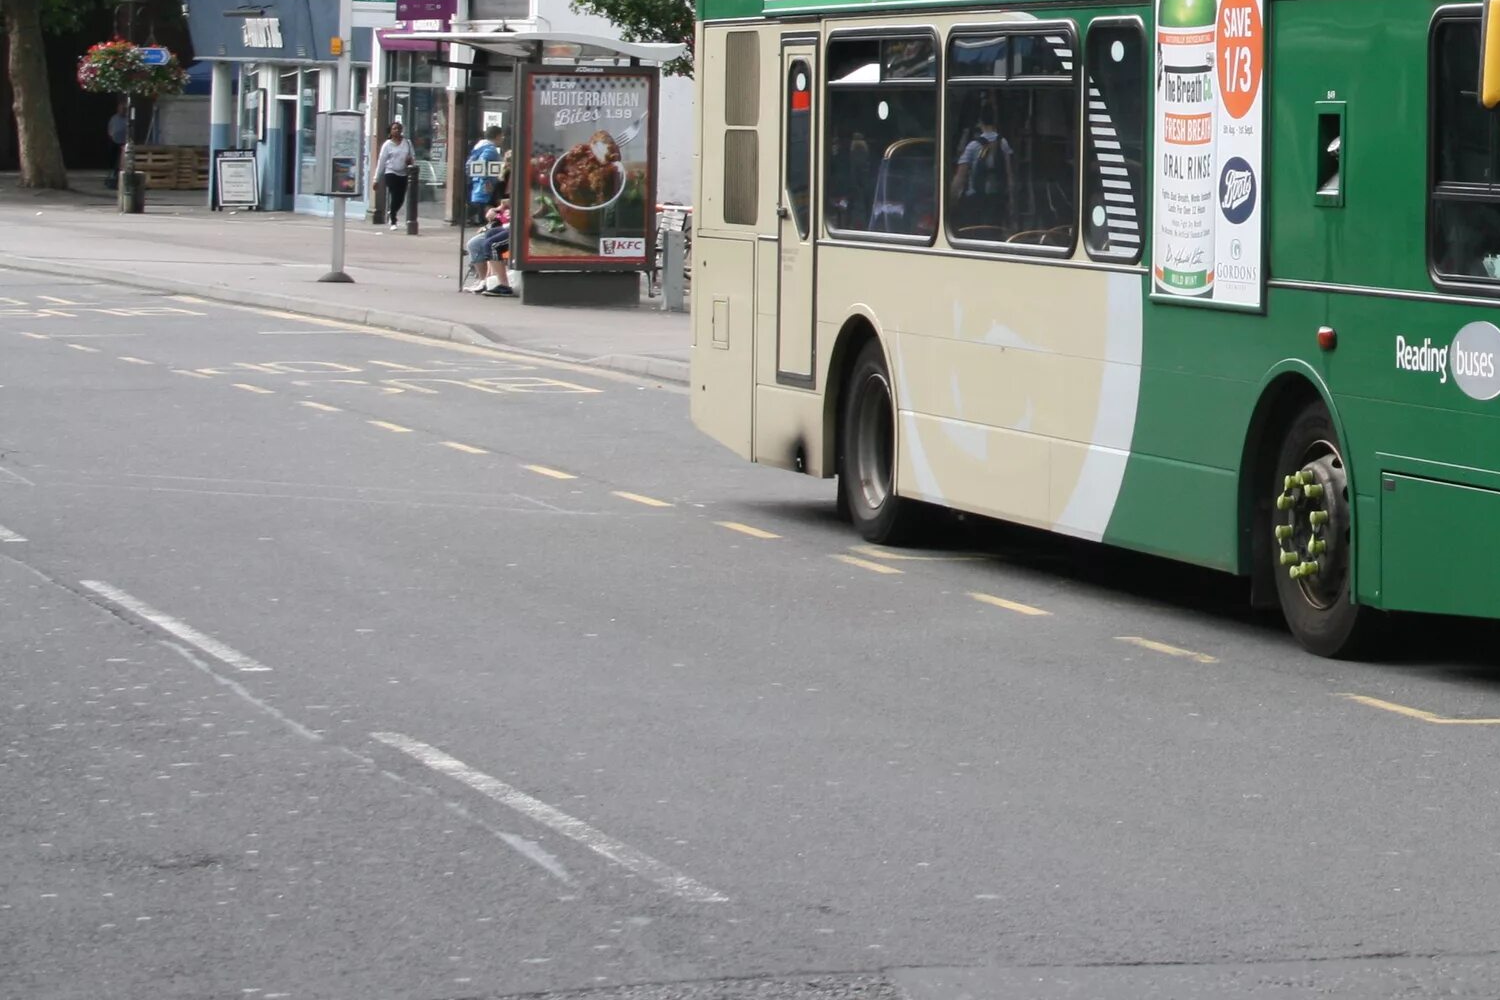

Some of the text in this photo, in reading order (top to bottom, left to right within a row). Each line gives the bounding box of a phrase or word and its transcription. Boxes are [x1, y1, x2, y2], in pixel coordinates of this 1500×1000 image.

[1223, 6, 1252, 38] SAVE
[1224, 45, 1252, 93] 1/3
[551, 81, 576, 89] NEW
[1165, 72, 1176, 102] The
[1177, 74, 1202, 103] Breath
[540, 90, 640, 106] MEDITERRANEAN
[554, 108, 632, 127] Bites 1.99
[1165, 117, 1211, 141] FRESH BREATH
[1163, 153, 1211, 180] ORAL RINSE
[616, 241, 642, 249] KFC
[1217, 262, 1256, 280] GORDONS
[1395, 335, 1495, 384] Reading buses
